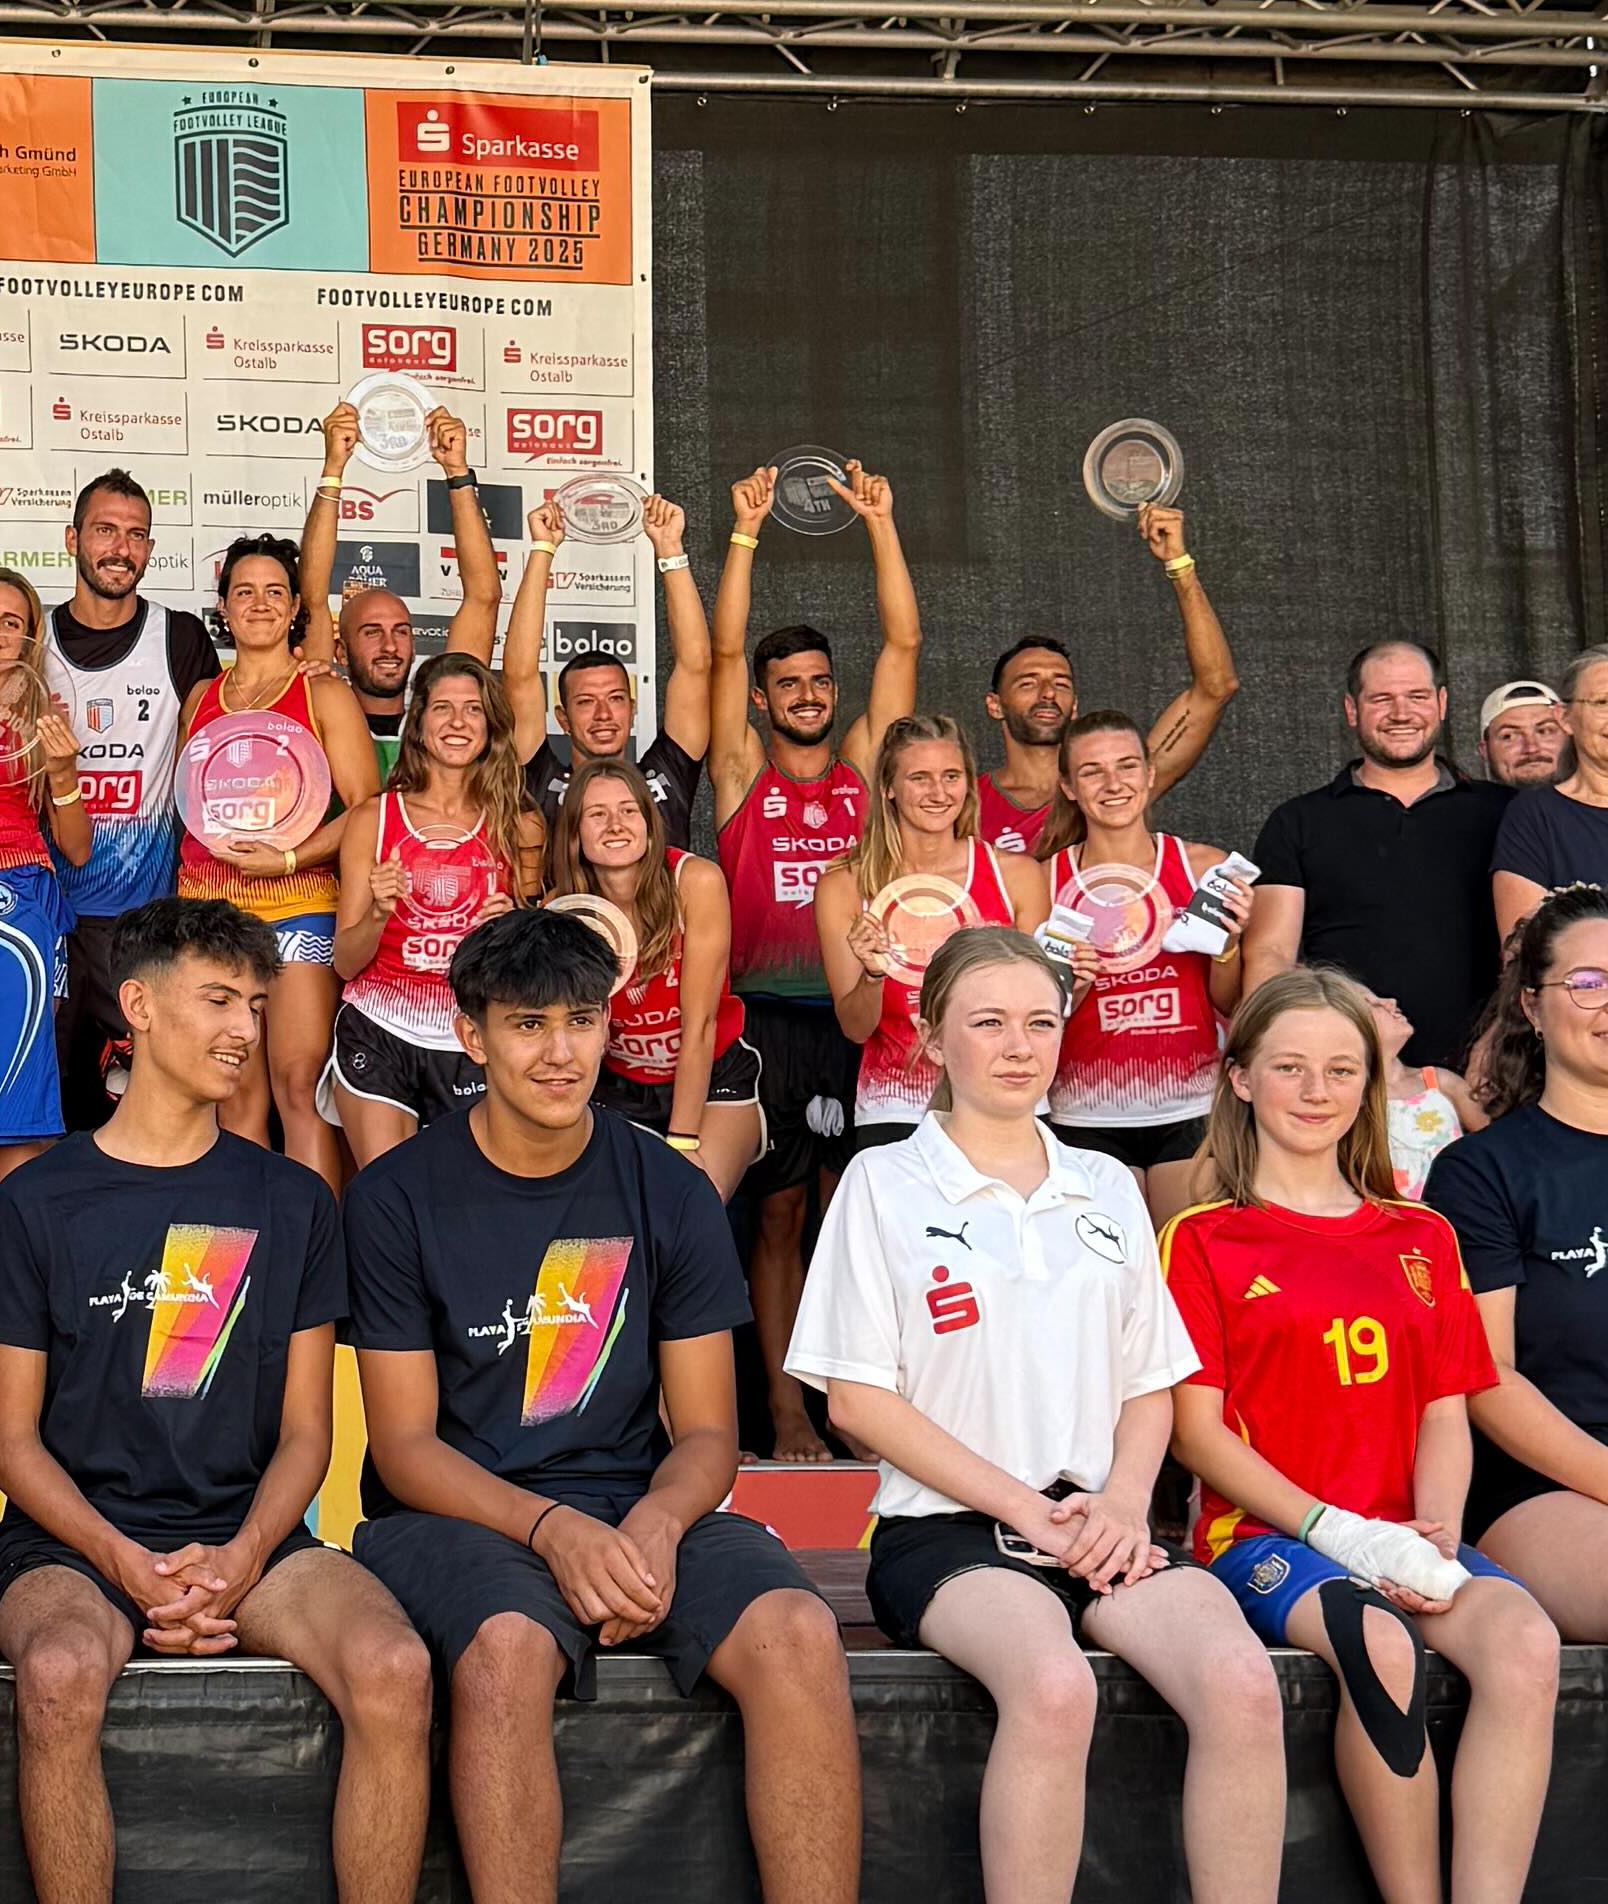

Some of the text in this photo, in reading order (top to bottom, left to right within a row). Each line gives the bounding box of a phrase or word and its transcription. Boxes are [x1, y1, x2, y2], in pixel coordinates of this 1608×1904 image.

[202, 91, 259, 104] EUROPEAN
[173, 113, 287, 136] FOOTVOLLEY LEAGUE
[16, 146, 76, 161] Gmünd
[462, 134, 579, 160] Sparkasse
[399, 169, 600, 198] EUROPEAN FOOTVOLLEY
[400, 194, 600, 232] CHAMPIONSHIP
[418, 232, 583, 265] GERMANY 2025
[234, 338, 334, 355] Kreissparkasse
[368, 330, 451, 365] sorg
[234, 356, 276, 369] Ostalb
[530, 353, 628, 369] Kreissparkasse
[530, 370, 573, 383] Ostalb
[80, 411, 182, 426] Kreissparkasse
[80, 428, 124, 441] Ostalb
[512, 414, 596, 449] sorg
[17, 488, 71, 496] Sparkassen
[204, 491, 302, 509] mülleroptik
[12, 498, 71, 508] Versicherung
[337, 500, 374, 520] BS
[351, 565, 382, 576] AQUA
[579, 573, 630, 582] Sparkassen
[575, 582, 630, 592] Versicherung
[556, 629, 632, 656] bolao
[127, 685, 160, 696] bolao
[138, 699, 150, 721] 2
[267, 721, 303, 734] bolao
[276, 734, 290, 756] 2
[78, 776, 136, 809] org
[208, 802, 270, 826] sorg
[844, 797, 855, 816] 1
[781, 867, 821, 887] so
[1104, 993, 1173, 1021] sorg
[1551, 1248, 1595, 1260] PLAYA
[89, 1293, 122, 1307] PLAYA
[129, 1292, 144, 1301] DE
[468, 1325, 506, 1337] PLAYA
[531, 1313, 587, 1325] AMUNDIA
[1323, 1316, 1389, 1386] 19
